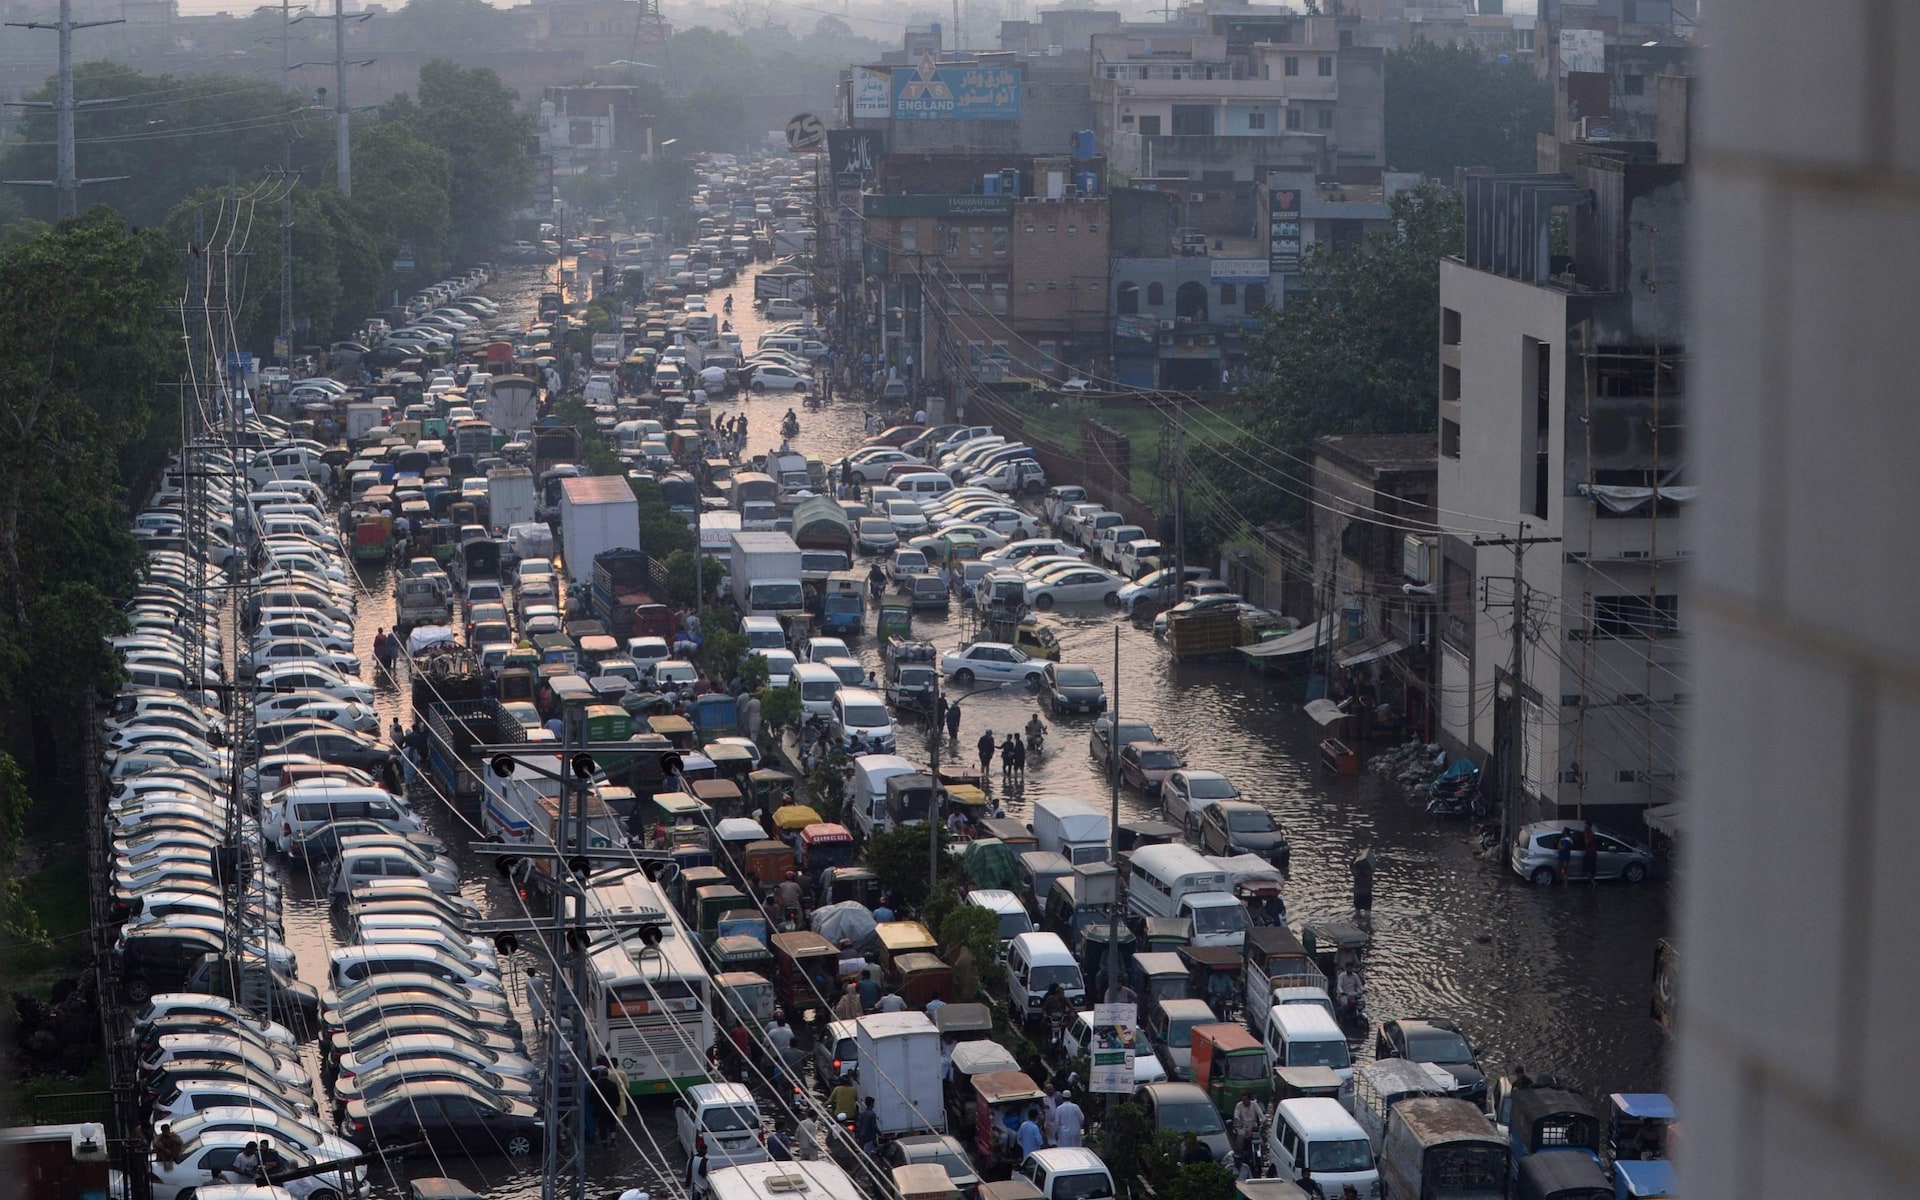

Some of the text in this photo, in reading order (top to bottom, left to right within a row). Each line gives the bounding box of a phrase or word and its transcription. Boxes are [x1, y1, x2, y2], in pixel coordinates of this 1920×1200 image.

[909, 86, 942, 95] T S
[898, 101, 954, 110] ENGLAND
[788, 115, 824, 148] ZS
